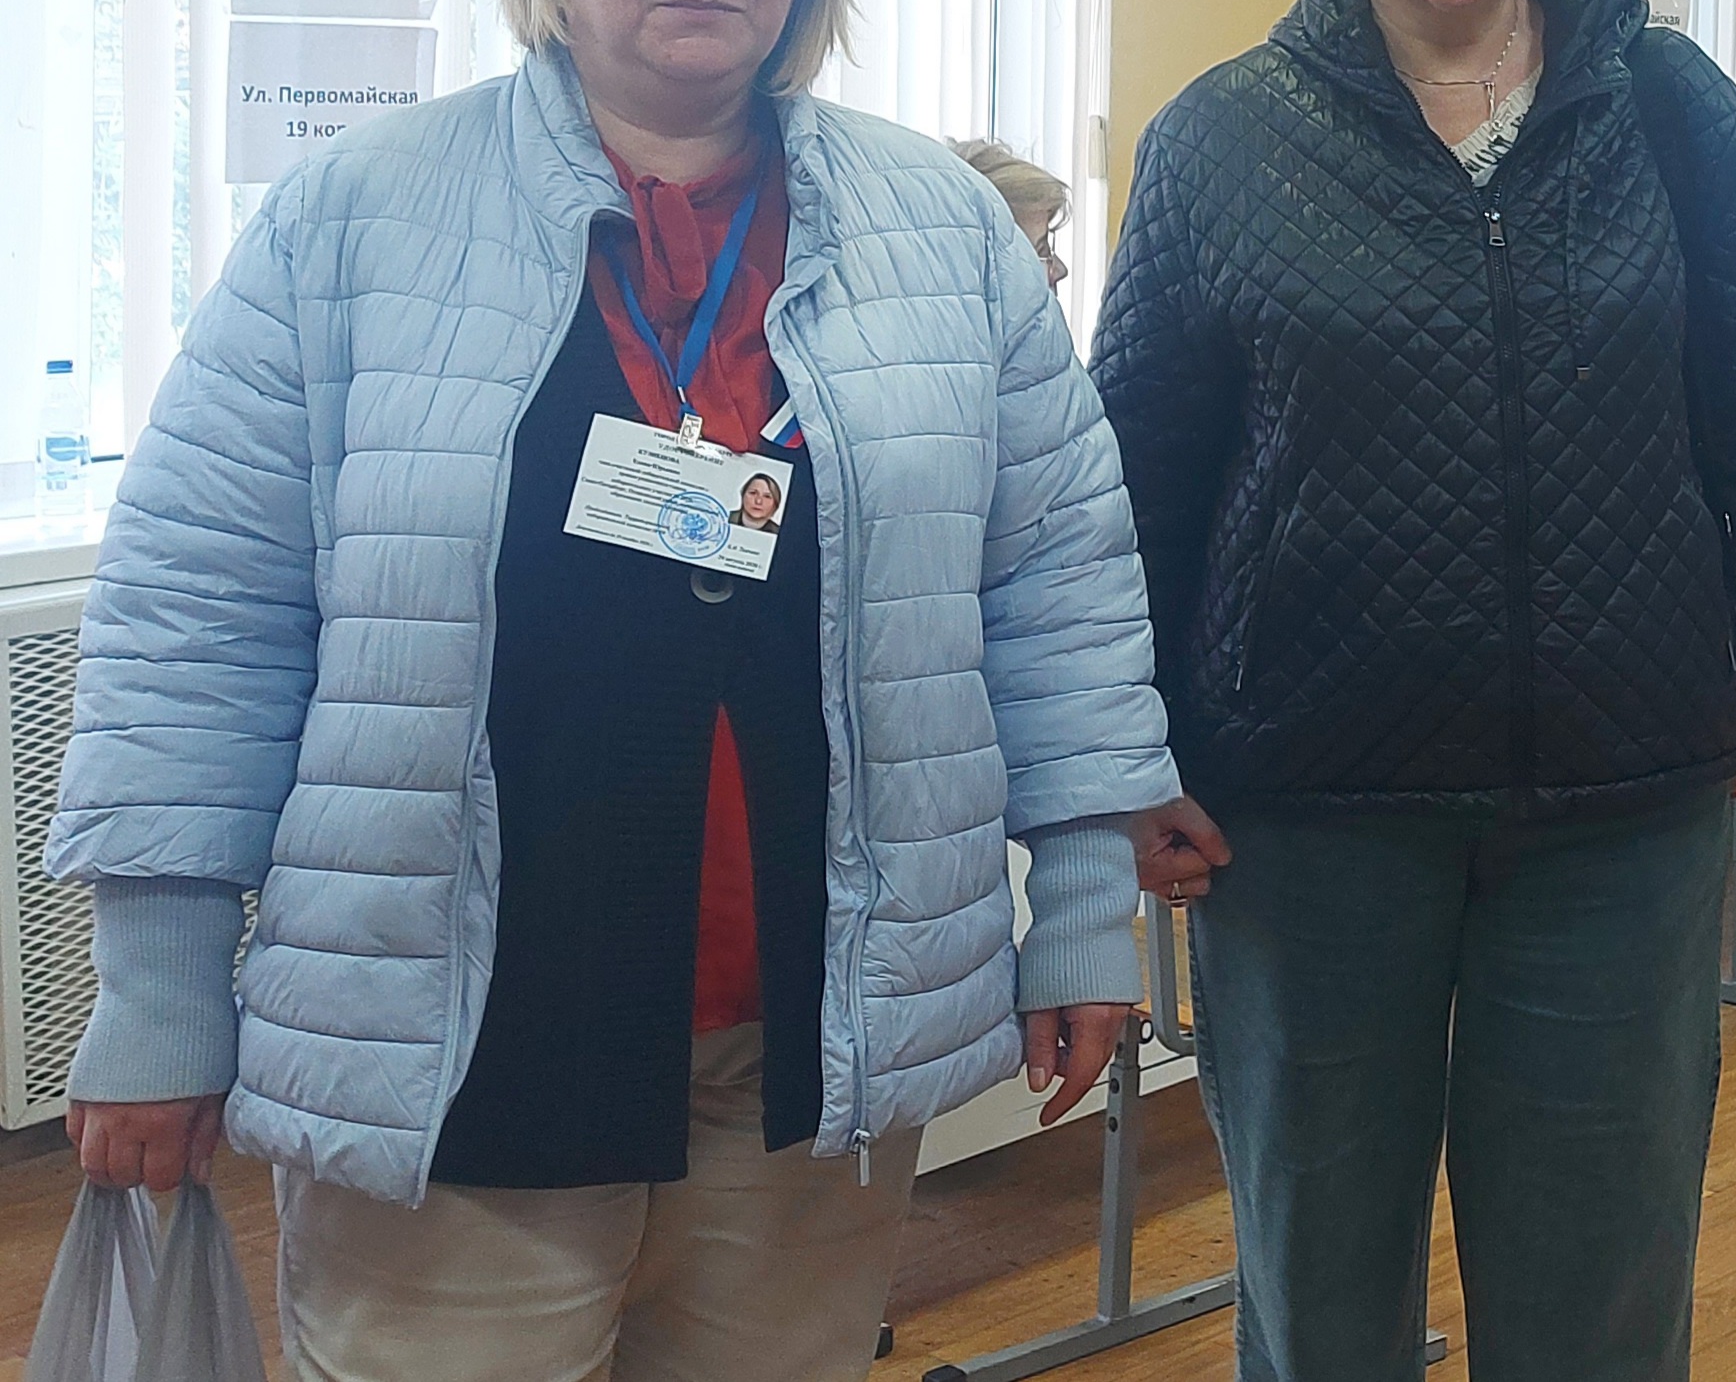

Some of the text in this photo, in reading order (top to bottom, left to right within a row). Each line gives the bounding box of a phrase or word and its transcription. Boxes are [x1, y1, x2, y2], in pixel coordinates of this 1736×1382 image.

[242, 86, 418, 107] Ул. Первомайская
[286, 121, 307, 138] 19
